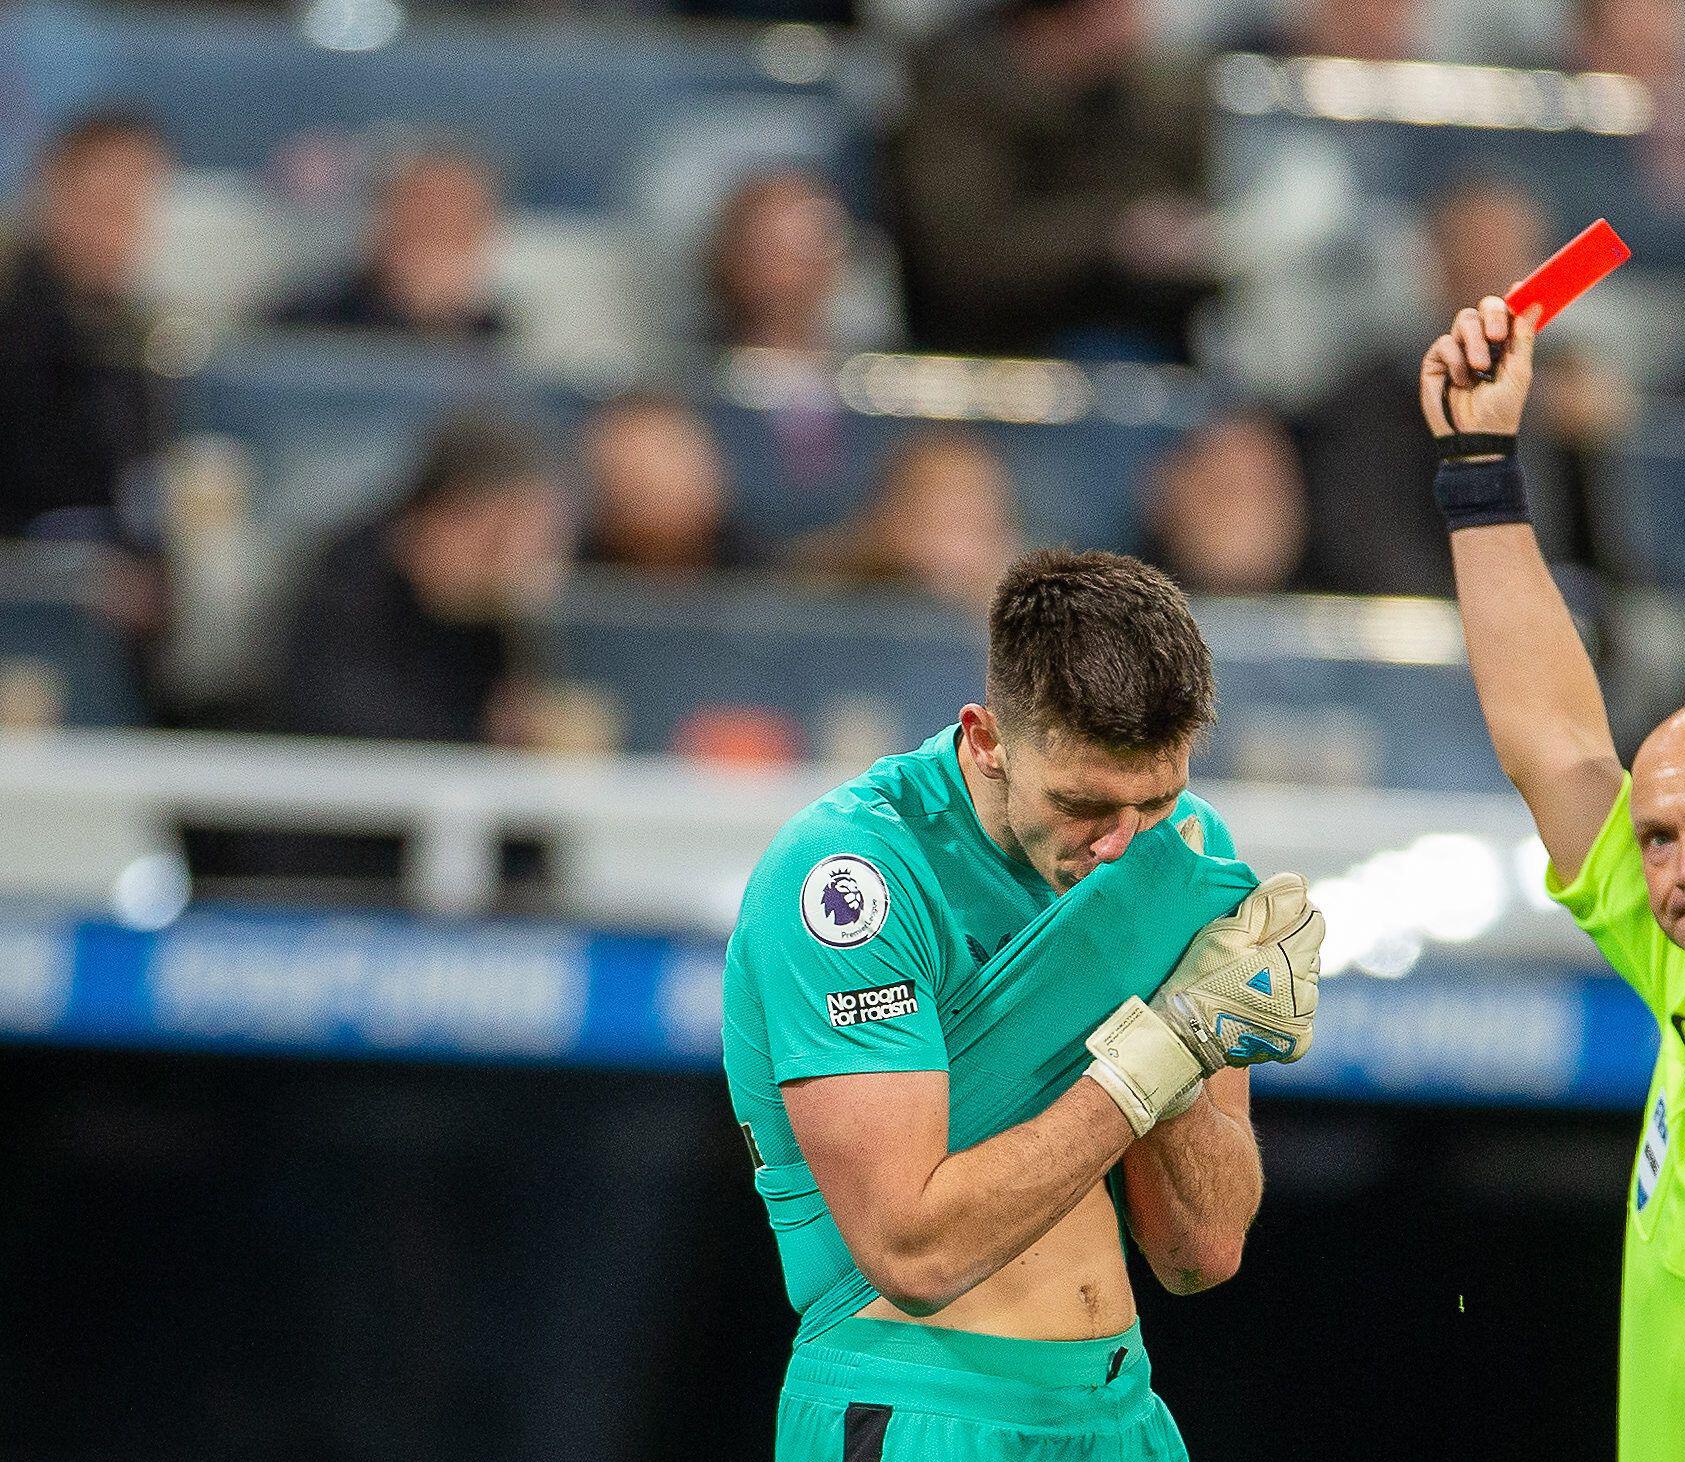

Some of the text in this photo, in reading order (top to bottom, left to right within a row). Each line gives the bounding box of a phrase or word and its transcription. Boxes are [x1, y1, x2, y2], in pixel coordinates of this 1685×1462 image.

[826, 984, 909, 1012] No room
[829, 997, 919, 1027] for racism
